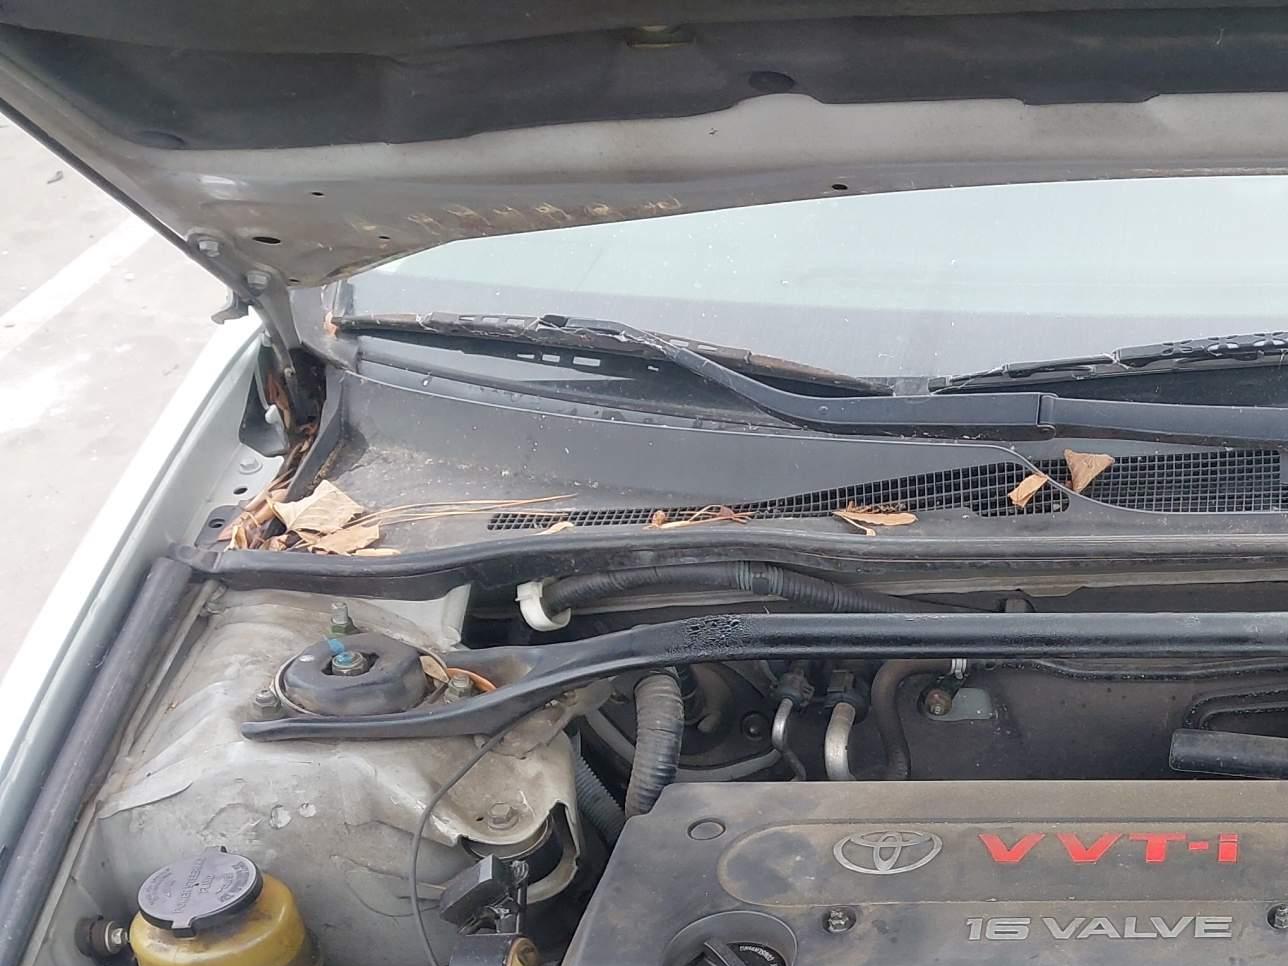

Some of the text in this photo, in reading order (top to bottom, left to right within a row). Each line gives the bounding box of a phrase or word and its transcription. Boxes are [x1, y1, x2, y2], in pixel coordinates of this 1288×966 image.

[978, 832, 1240, 864] VVT-i
[966, 915, 1234, 942] 16 VALVE
